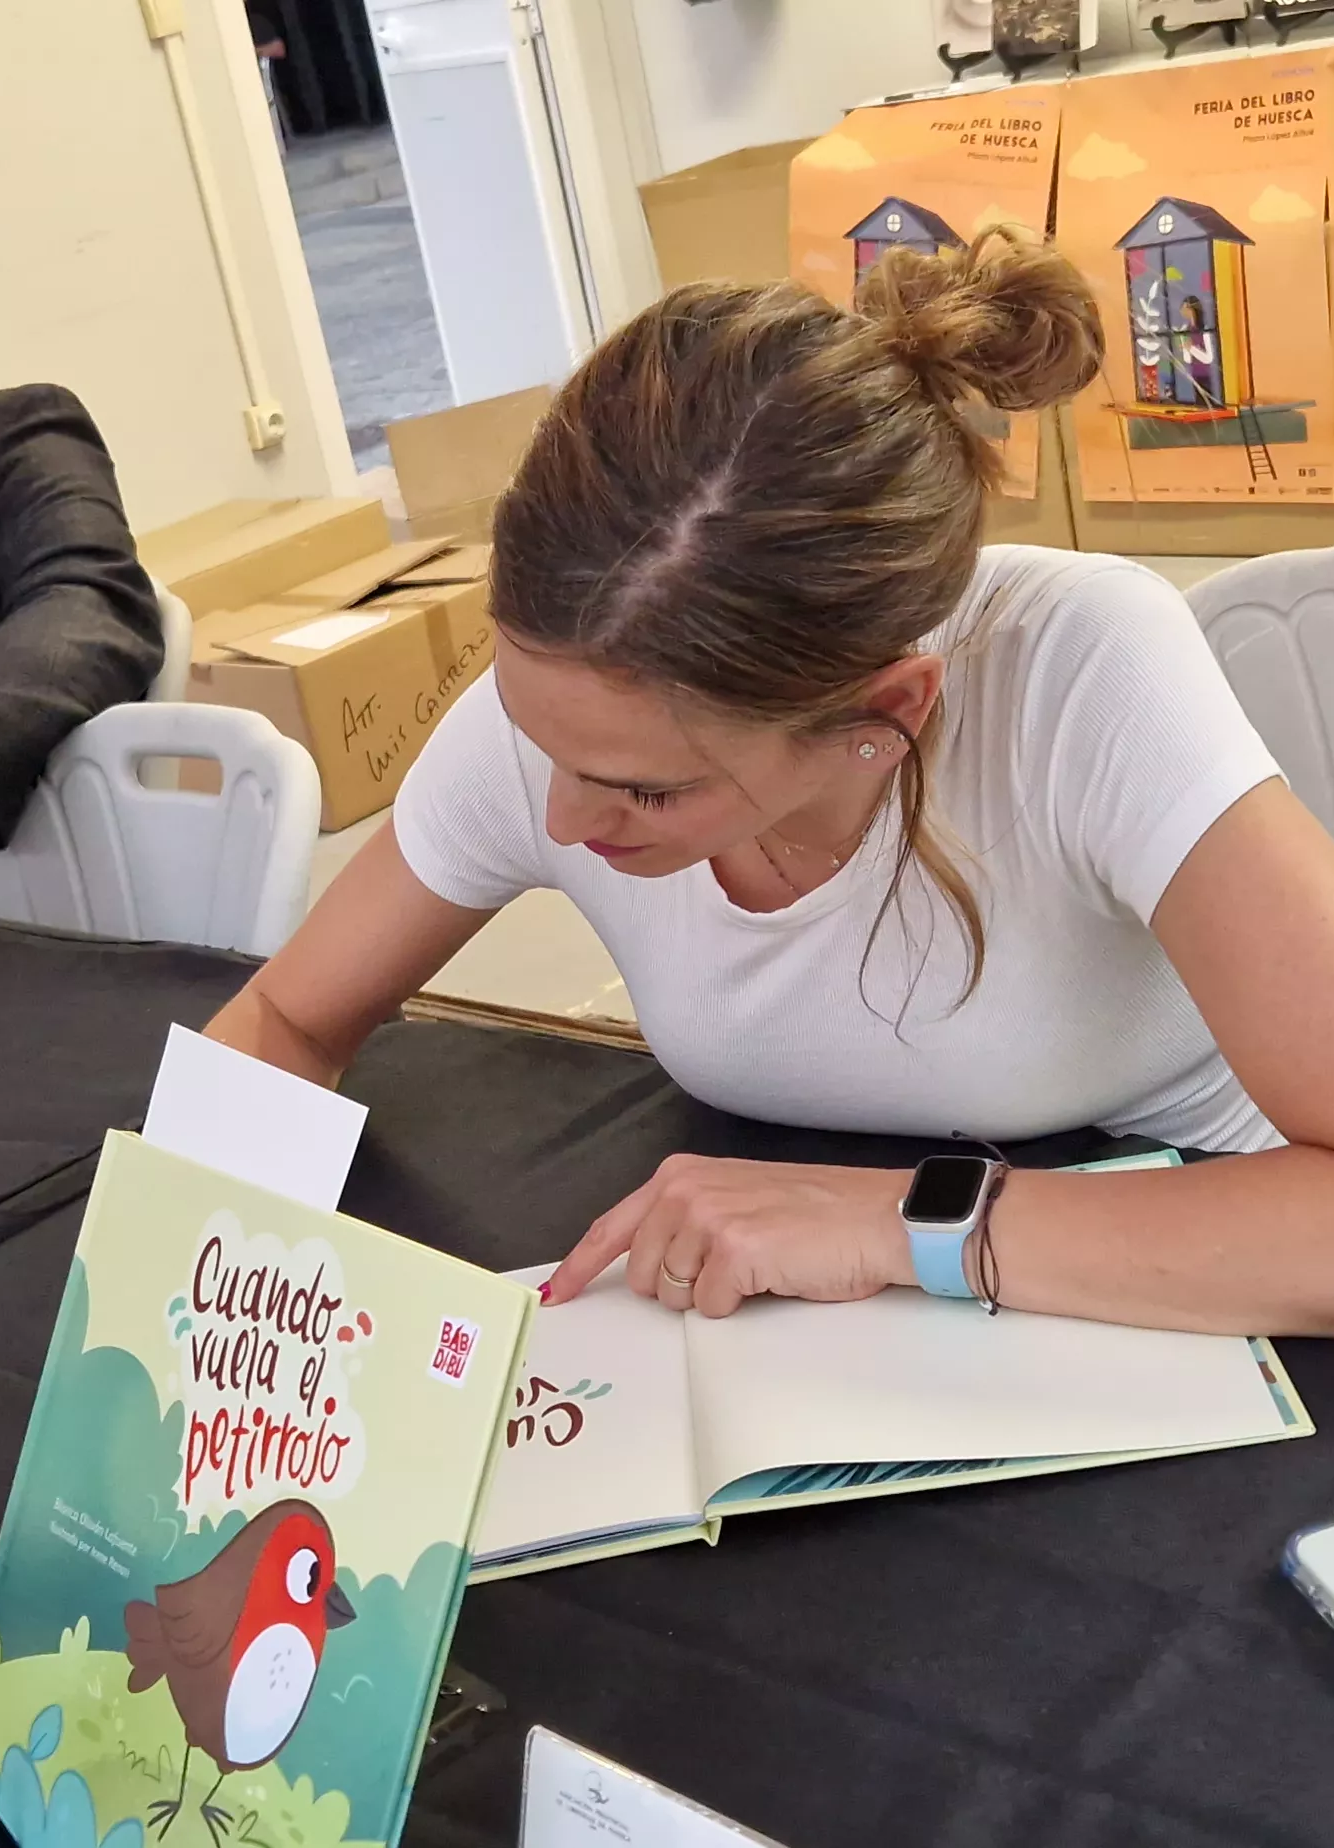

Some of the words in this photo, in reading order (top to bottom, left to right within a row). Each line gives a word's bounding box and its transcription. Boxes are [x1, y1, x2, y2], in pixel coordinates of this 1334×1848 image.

[1194, 101, 1233, 115] FERIA
[1240, 95, 1266, 109] DEL
[1272, 89, 1315, 106] LIBRO
[930, 122, 967, 132] FERIA
[970, 118, 993, 129] DEL
[1000, 118, 1042, 132] LIBRO
[1234, 115, 1251, 129] DE
[1258, 109, 1313, 126] HUESCA
[960, 134, 976, 145] DE
[983, 135, 1039, 149] HUESCA
[192, 1235, 343, 1346] Cuando
[191, 1326, 280, 1401] vuela
[299, 1346, 327, 1417] el
[184, 1396, 351, 1506] petirrojo
